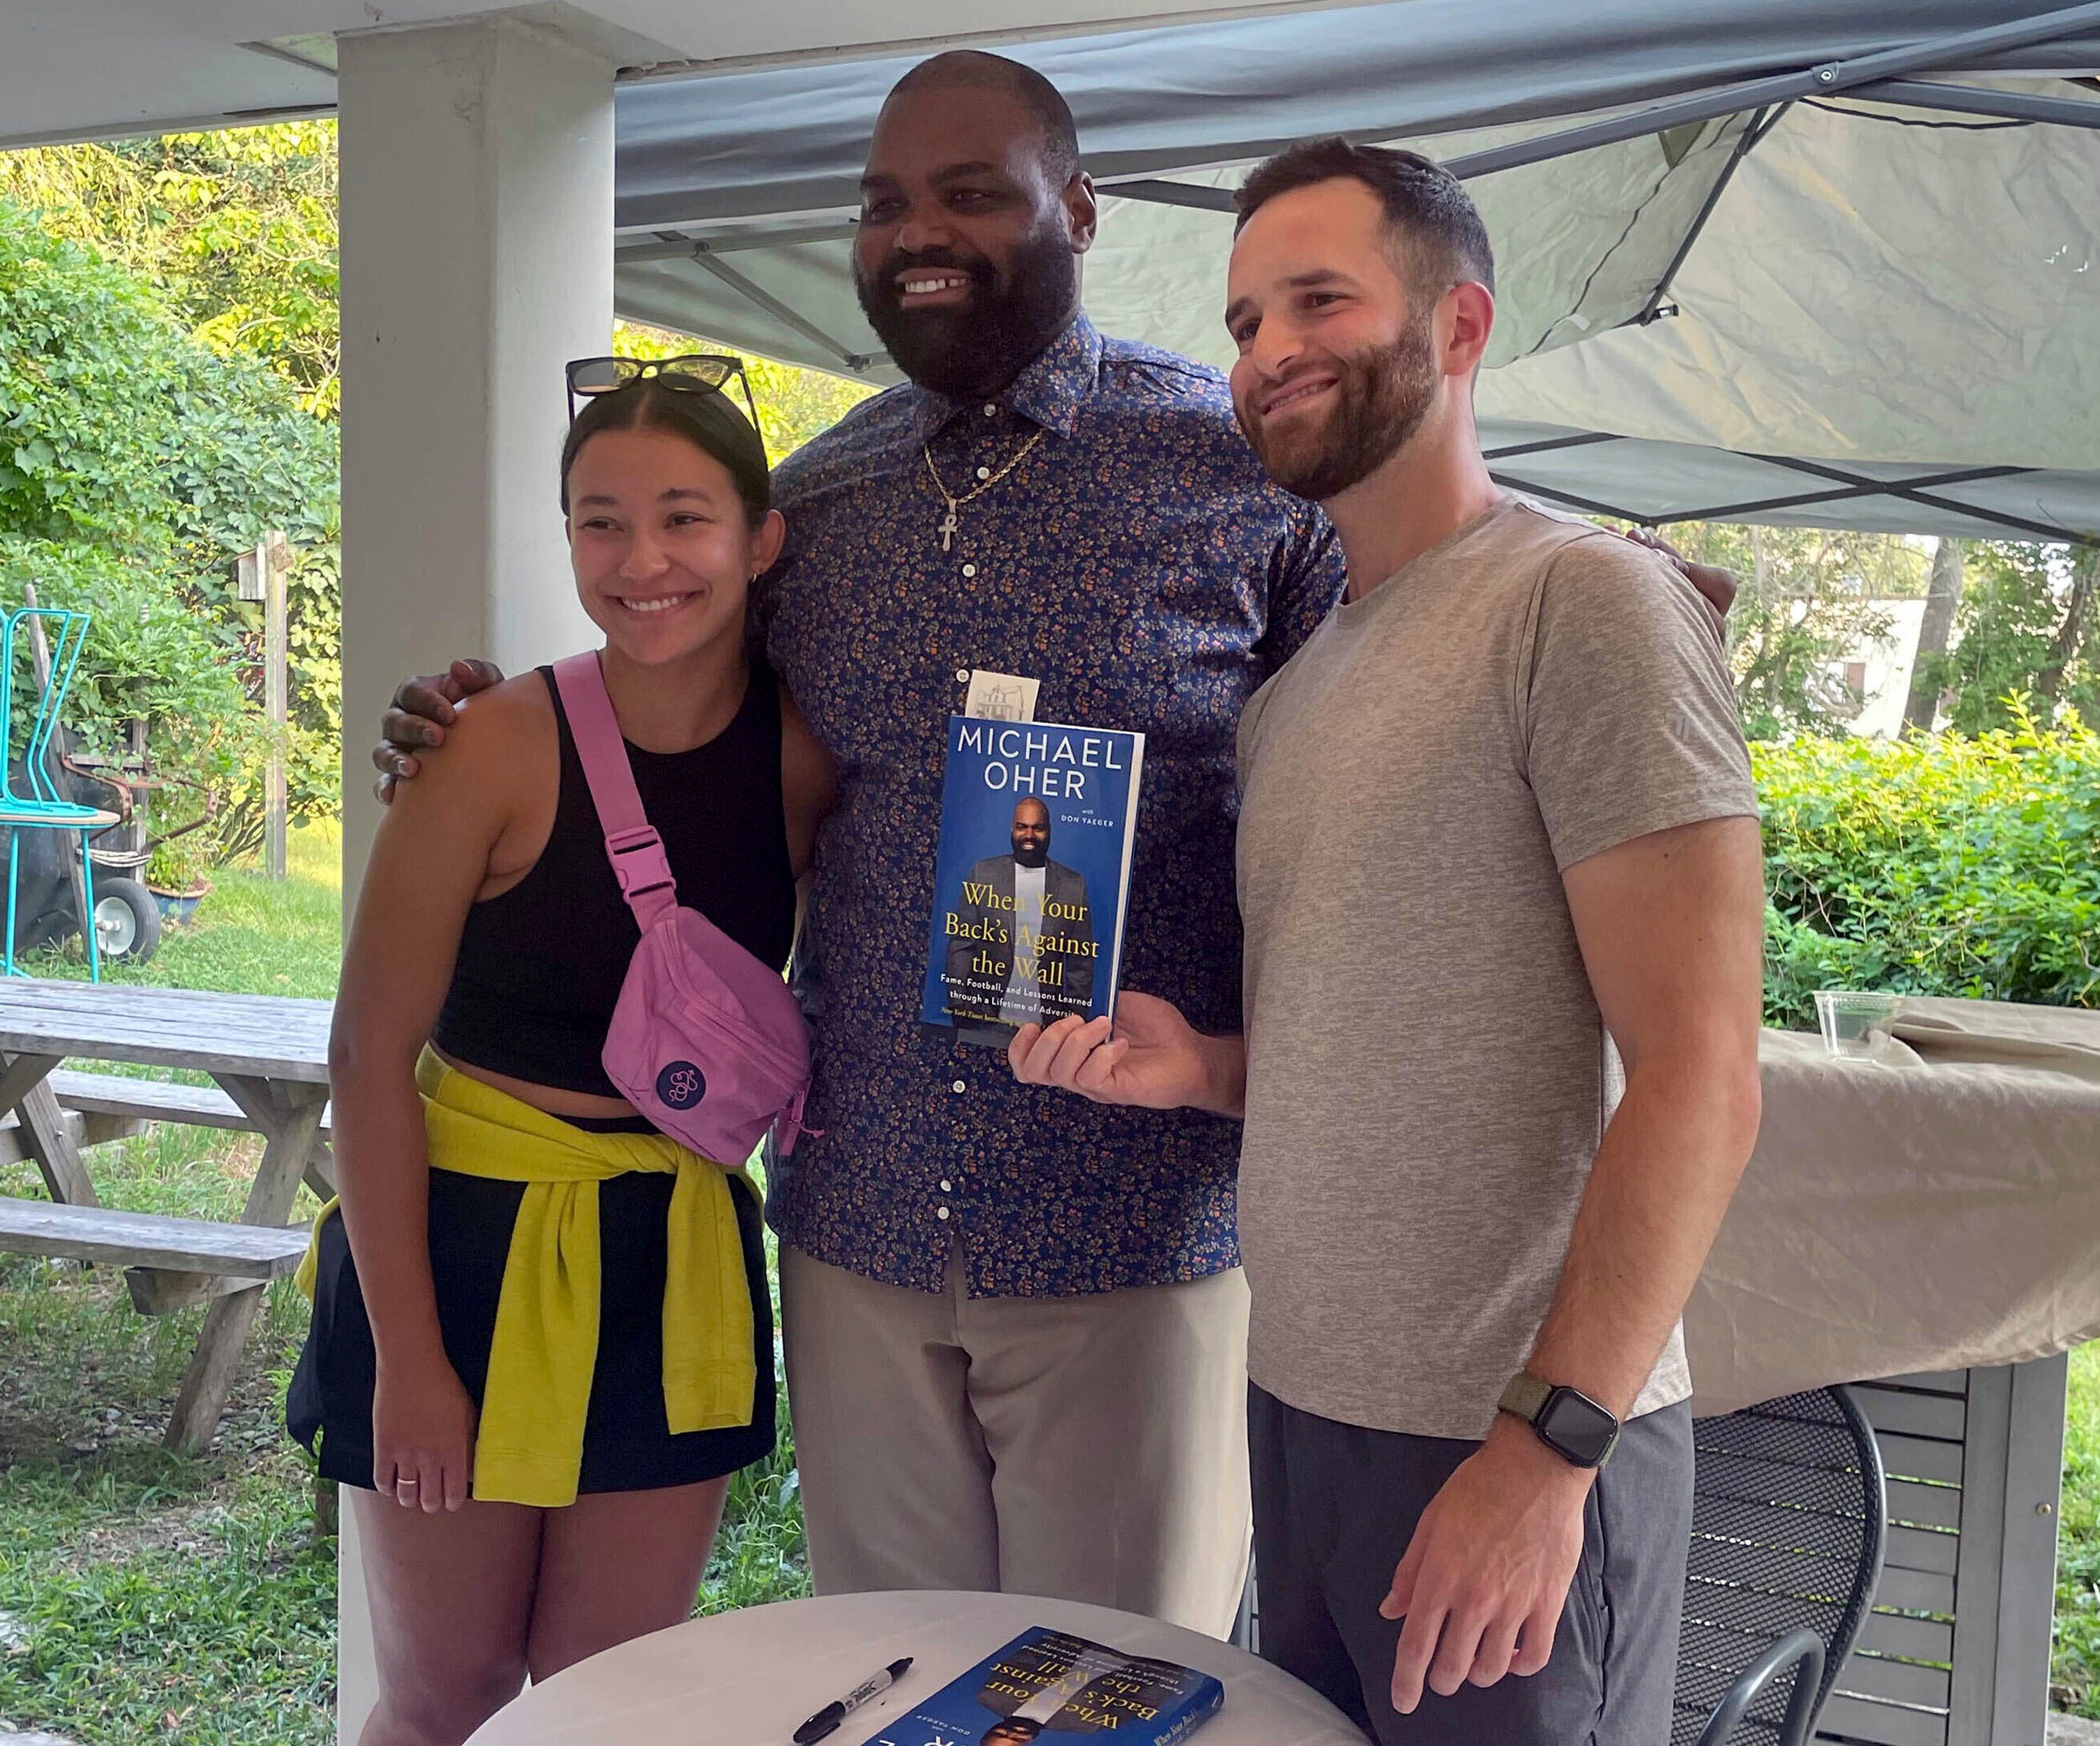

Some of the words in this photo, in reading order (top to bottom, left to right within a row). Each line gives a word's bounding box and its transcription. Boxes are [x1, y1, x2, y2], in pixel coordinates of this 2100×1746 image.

[958, 725, 1121, 769] MICHAEL
[984, 762, 1086, 799] OHER
[1082, 818, 1114, 827] YAEGER
[962, 881, 1026, 912] When
[1038, 892, 1088, 922] Your
[945, 912, 1008, 944] Back's
[1016, 925, 1100, 958] Against
[972, 951, 1006, 977] the
[1014, 956, 1063, 986] Wall
[941, 974, 965, 986] Fame,
[967, 978, 1003, 993] Football,
[1006, 986, 1021, 995] and
[1024, 989, 1056, 1001] Lessons
[1058, 993, 1092, 1007] Learned
[950, 991, 982, 1005] through
[992, 997, 1026, 1010] Lifetime
[1028, 1002, 1037, 1012] of
[1039, 1005, 1074, 1017] Adversi
[986, 1681, 1037, 1705] Your
[1102, 1678, 1141, 1693] the
[1084, 1690, 1160, 1721] Back's
